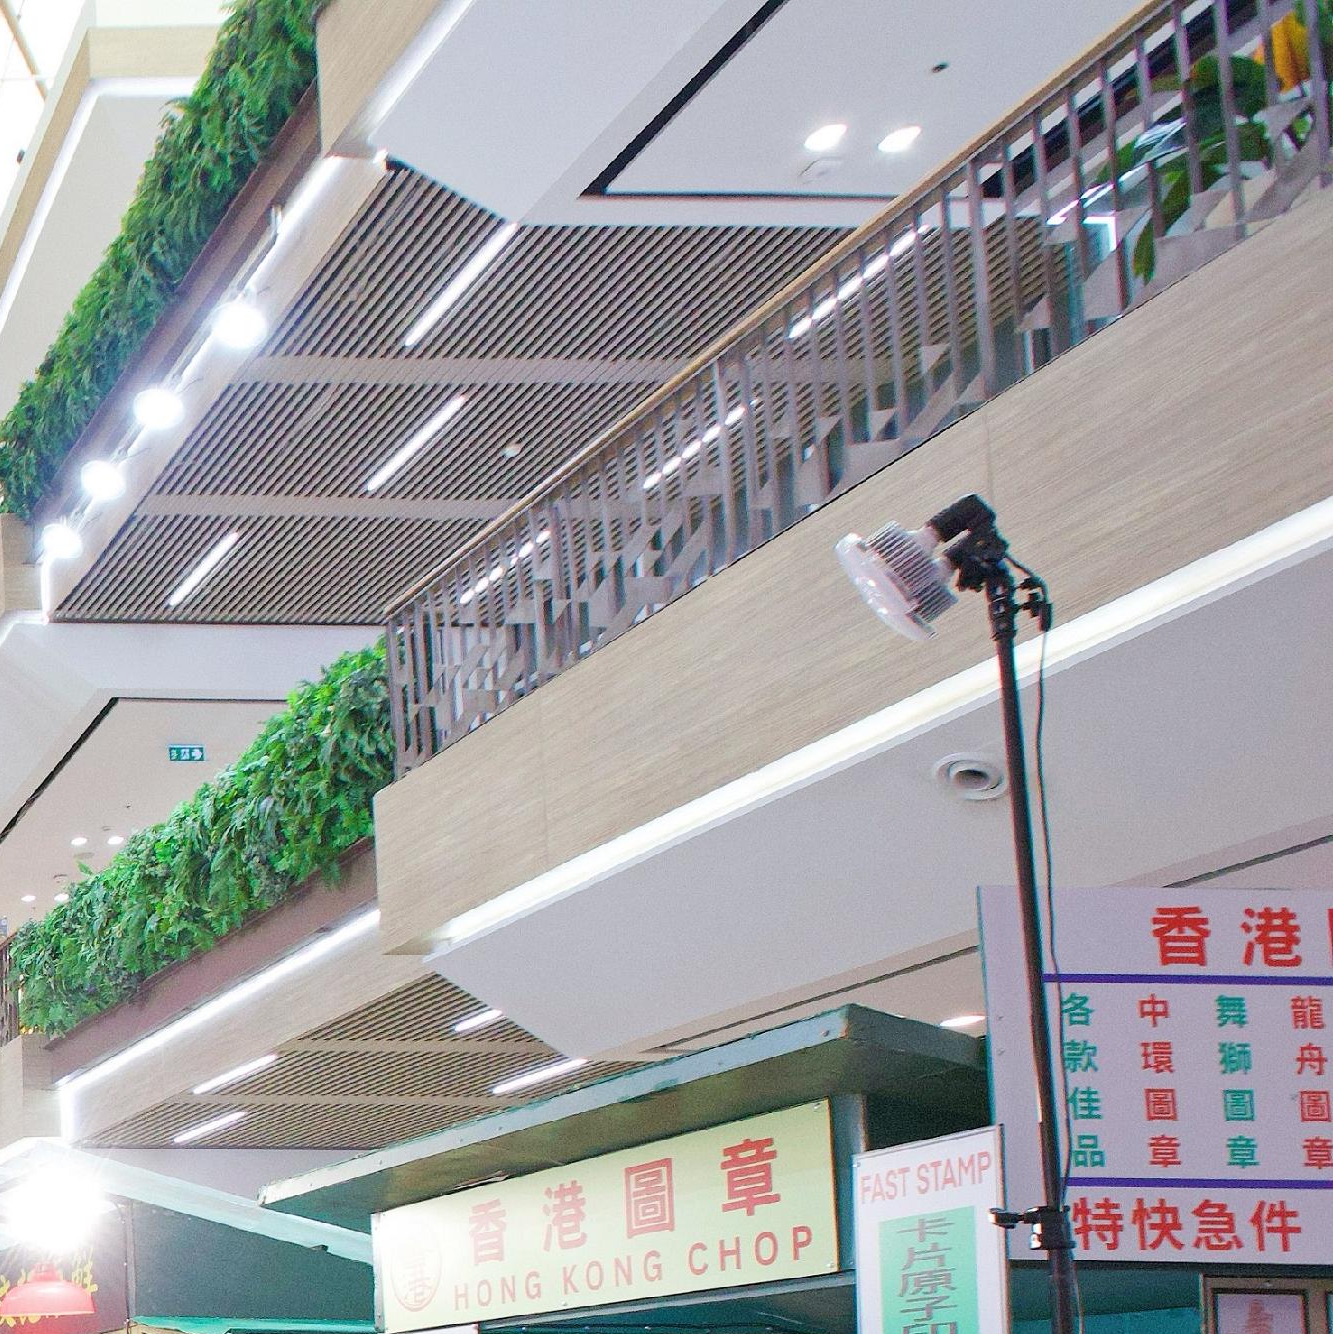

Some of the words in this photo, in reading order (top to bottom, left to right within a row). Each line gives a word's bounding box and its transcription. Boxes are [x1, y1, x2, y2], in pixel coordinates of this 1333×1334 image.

[1151, 905, 1333, 968] 香港
[1063, 992, 1105, 1168] 各款佳品
[1138, 993, 1181, 1168] 中環圖章
[1216, 994, 1260, 1169] 舞獅圖章
[1290, 995, 1333, 1170] 龍舟圖章
[469, 1137, 781, 1267] 香港圖章
[860, 1163, 909, 1205] FAST
[915, 1150, 993, 1197] STAMP
[1072, 1197, 1302, 1252] 特快急件
[454, 1265, 543, 1312] HONG
[563, 1248, 663, 1296] KONG
[688, 1224, 814, 1277] CHOP
